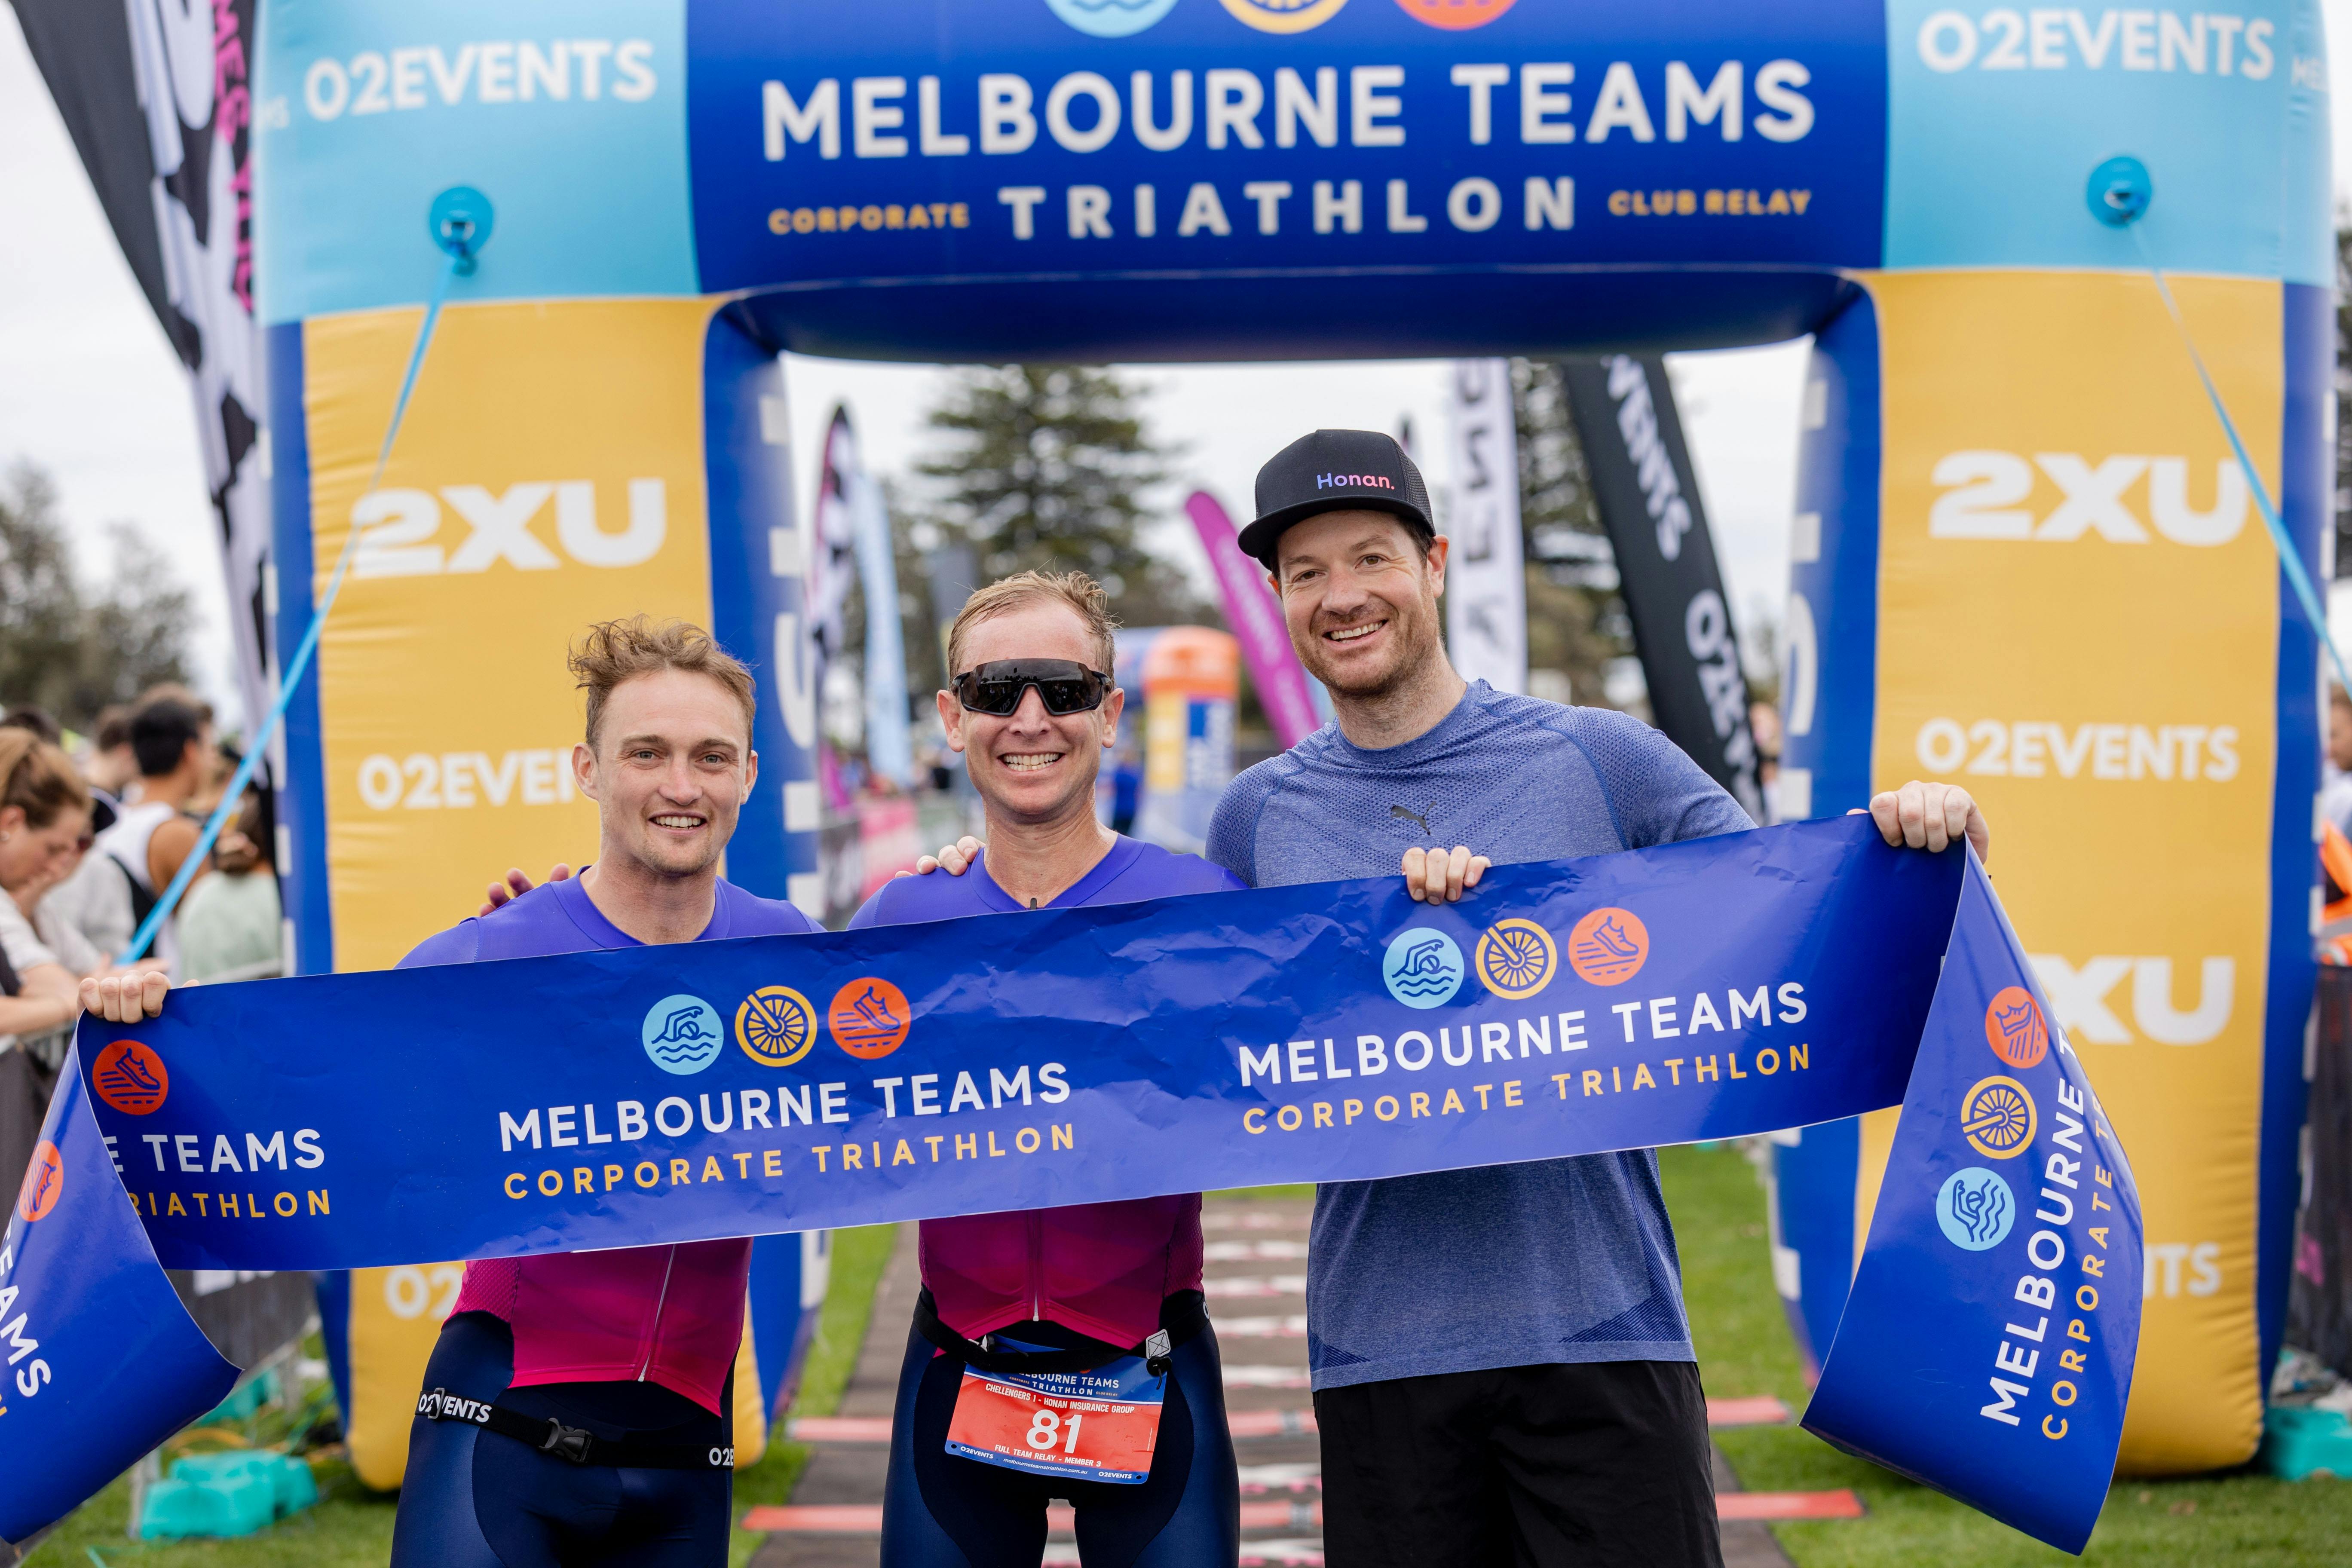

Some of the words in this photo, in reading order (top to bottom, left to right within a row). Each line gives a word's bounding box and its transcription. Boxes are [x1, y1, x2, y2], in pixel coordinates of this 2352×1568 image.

[1917, 9, 2275, 80] O2EVENTS
[763, 66, 1406, 161] MELBOURNE
[1451, 59, 1815, 144] TEAMS
[769, 203, 969, 234] CORPORATE
[997, 176, 1575, 239] TRIATHLON
[1608, 191, 1697, 216] CLUB
[1704, 189, 1812, 215] RELAY
[1317, 473, 1395, 490] Honan.
[1928, 449, 2248, 547] 2XU
[352, 478, 666, 579] 2XU
[1915, 717, 2239, 781] O2EVENTS
[2028, 953, 2237, 1046] XU
[1239, 1010, 1588, 1087] MELBOURNE
[1612, 982, 1807, 1043] TEAMS
[499, 1081, 849, 1151] MELBOURNE
[873, 1063, 1070, 1118] TEAMS
[1243, 1080, 1523, 1134] CORPORATE
[1552, 1044, 1809, 1099] TRIATHLON
[142, 1129, 325, 1172] TEAMS
[505, 1150, 782, 1199] CORPORATE
[812, 1123, 1074, 1172] TRIATHLON
[128, 1189, 330, 1217] RIATHLON
[1980, 1078, 2085, 1427] MELBOURNE
[2042, 1164, 2112, 1440] CORPORATE
[986, 1383, 1031, 1401] CHELLENGERS
[1044, 1397, 1067, 1409] HONAN
[1069, 1401, 1109, 1412] INSURANCE
[1112, 1405, 1135, 1413] GROUP
[1009, 1376, 1030, 1384] CORPORATE
[1032, 1381, 1093, 1395] TRIATHLON
[1081, 1377, 1119, 1388] TEAMS
[960, 1446, 994, 1459] O2EVENTS
[994, 1444, 1010, 1454] FULL
[1013, 1449, 1032, 1458] TEAM
[1034, 1453, 1056, 1461] RELAY
[1064, 1457, 1094, 1466] MEMBER
[1026, 1409, 1082, 1453] 81
[1003, 1458, 1088, 1474] melbourneteamstriathlon.com.au
